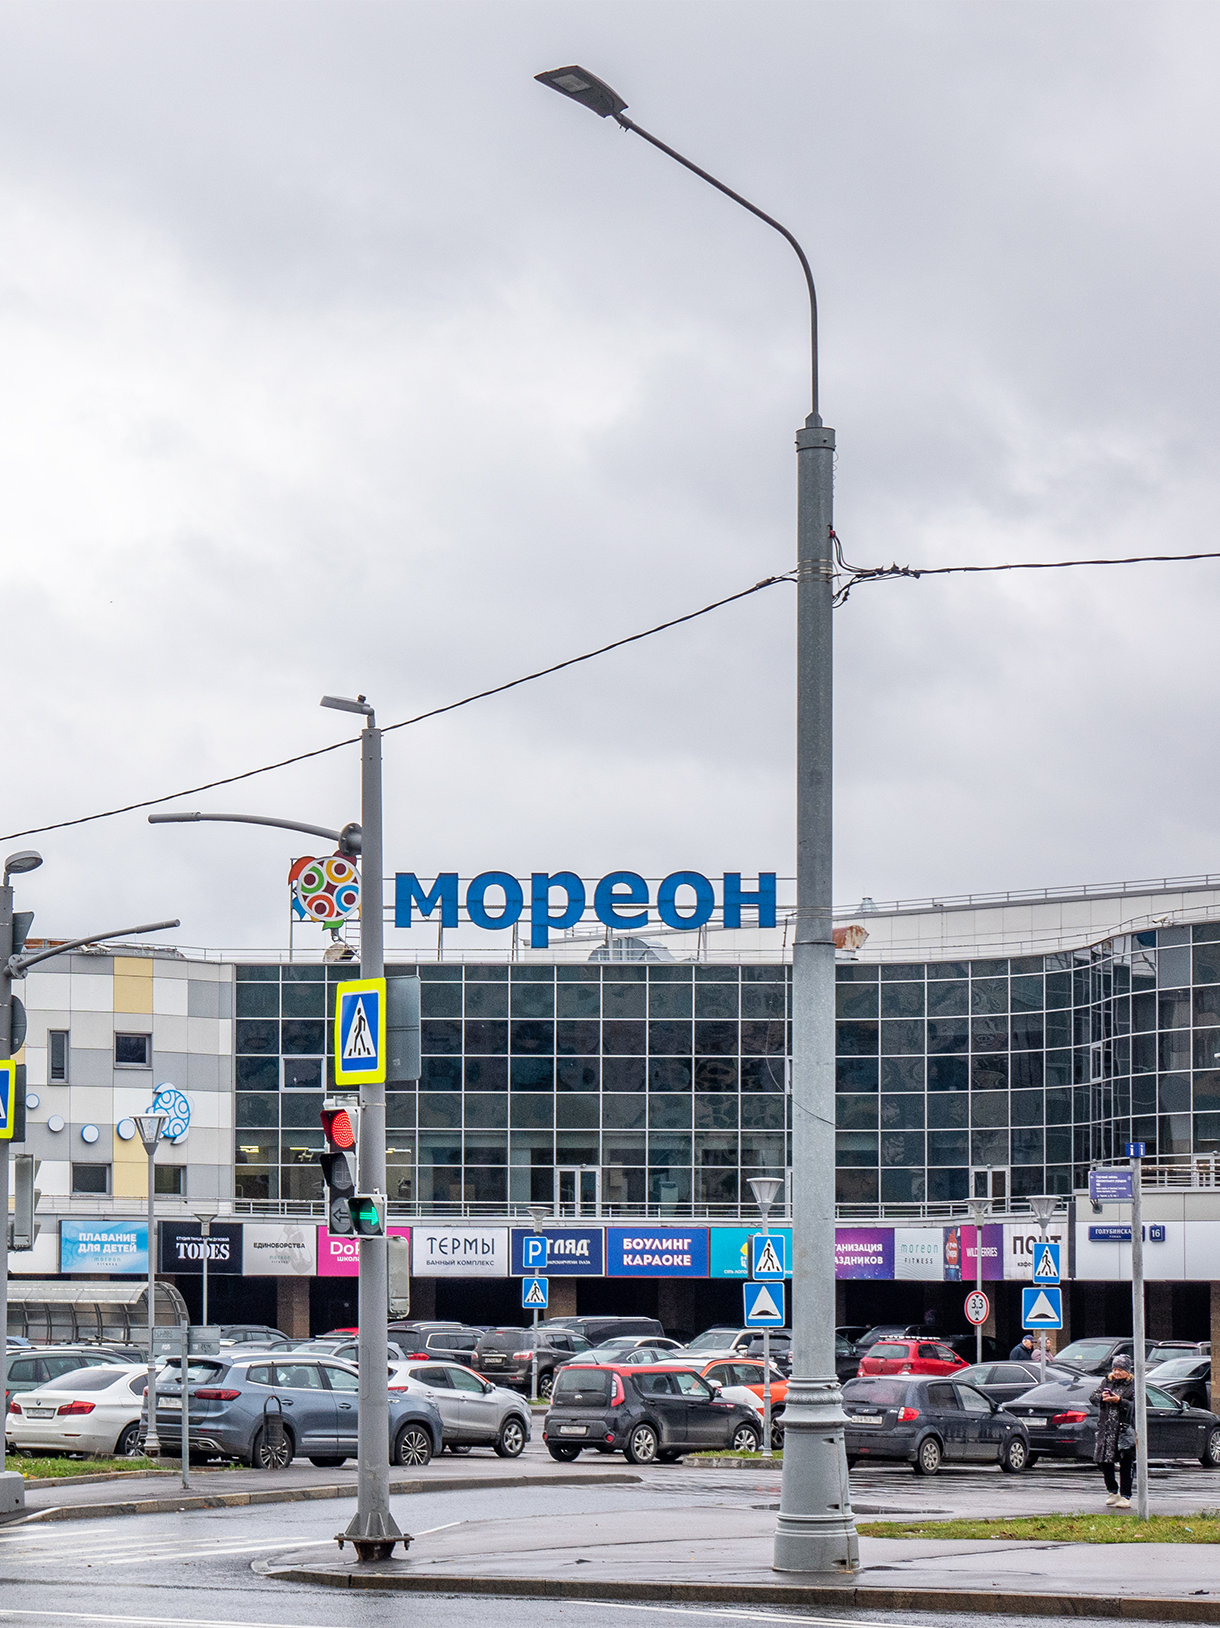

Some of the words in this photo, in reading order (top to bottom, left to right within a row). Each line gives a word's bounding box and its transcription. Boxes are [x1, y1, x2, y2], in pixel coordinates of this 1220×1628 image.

[394, 871, 777, 949] мореон
[78, 1232, 137, 1242] ПЛАВАНИЕ
[1151, 1228, 1161, 1238] 16
[78, 1243, 100, 1254] ДЛЯ
[102, 1242, 137, 1254] ДЕТЕЙ
[546, 1239, 589, 1257] ГЛЯД
[622, 1238, 692, 1250] БОУЛИНГ
[834, 1243, 883, 1253] АНИЗАЦИЯ
[900, 1244, 939, 1254] moreon
[175, 1243, 230, 1260] TODES
[965, 1247, 998, 1257] WILDERRIES
[622, 1254, 692, 1266] КАРАОКЕ
[834, 1256, 884, 1265] АЗДНИКОВ
[904, 1257, 933, 1265] FITNESS
